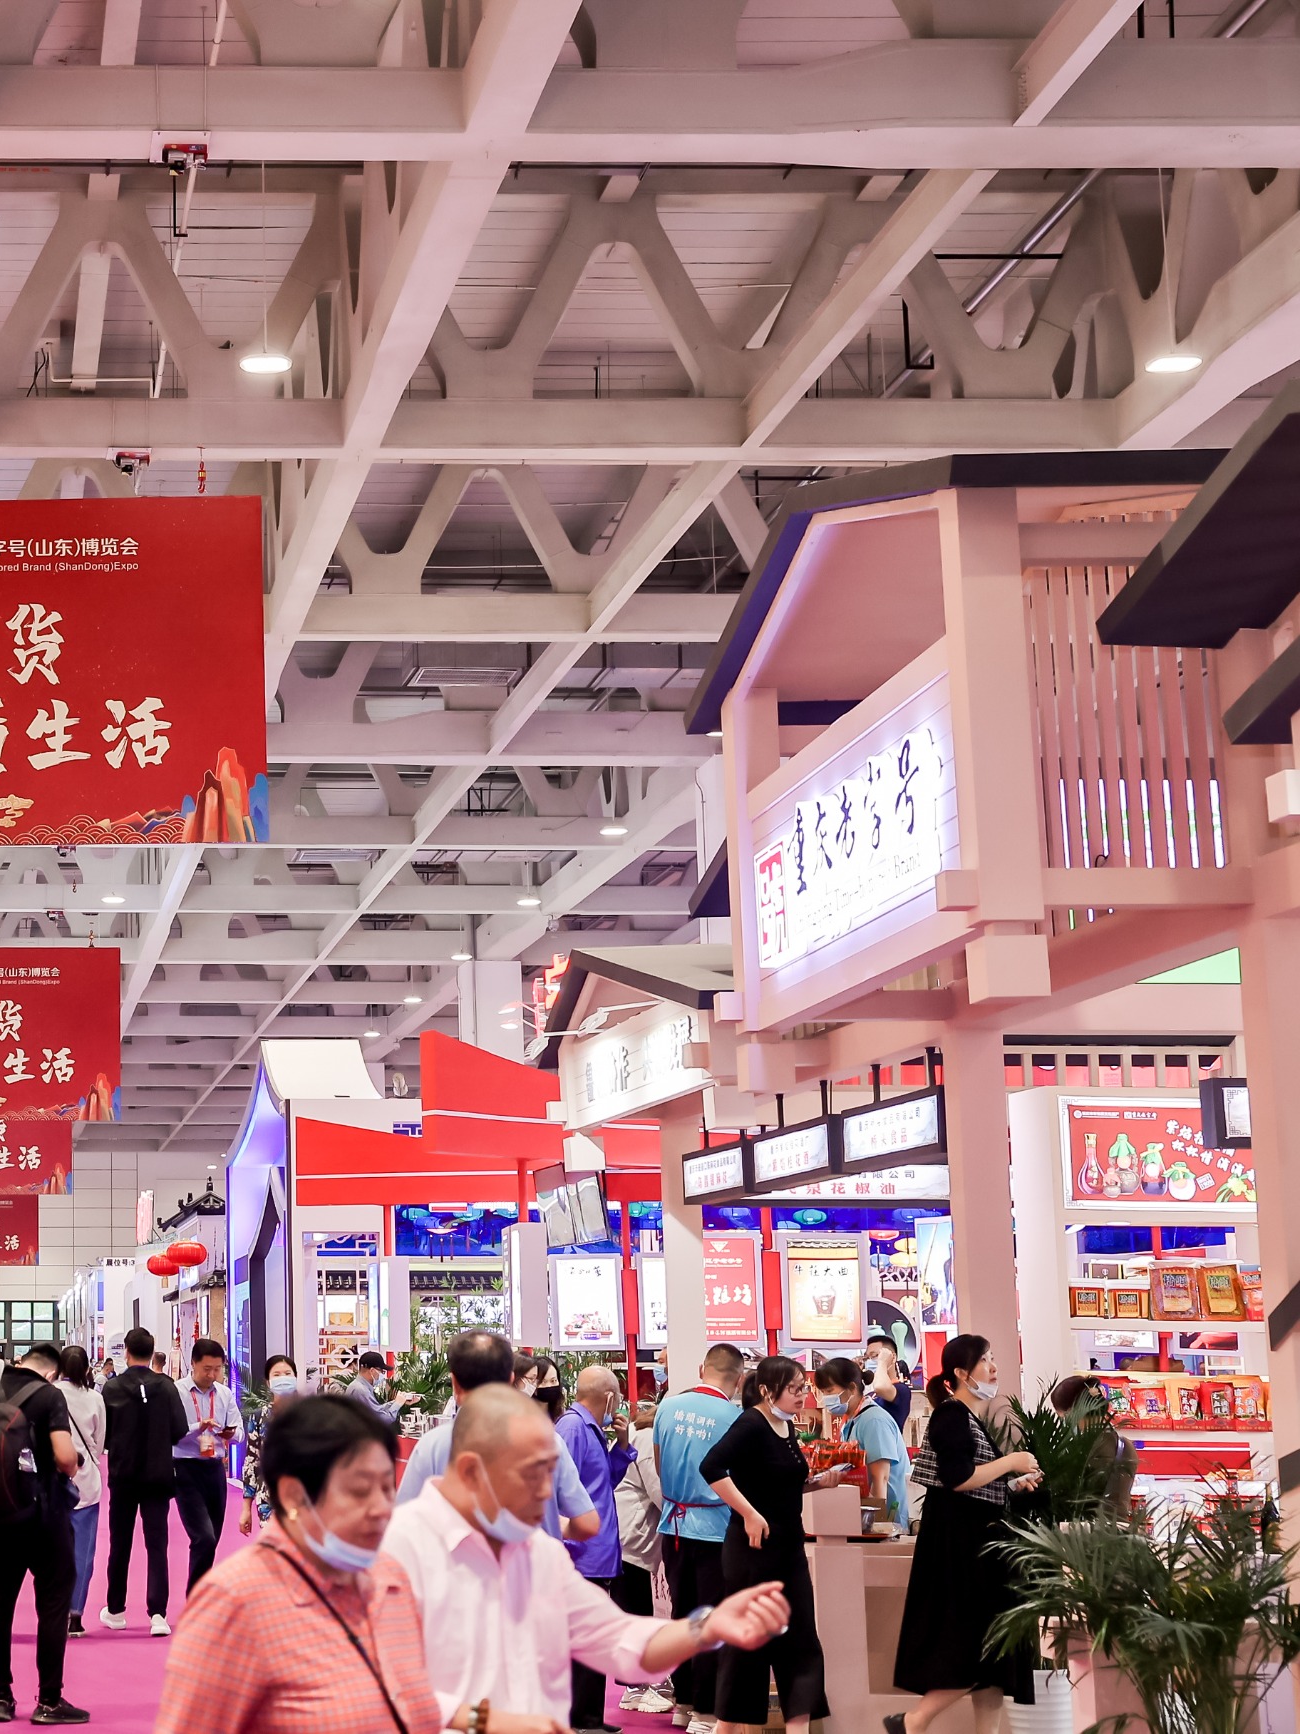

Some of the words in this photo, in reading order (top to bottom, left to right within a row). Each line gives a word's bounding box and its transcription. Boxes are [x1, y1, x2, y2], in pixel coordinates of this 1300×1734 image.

[22, 562, 51, 572] Brand
[54, 561, 139, 573] (ShanDong)Expo
[789, 1182, 895, 1195] 泉花椒油
